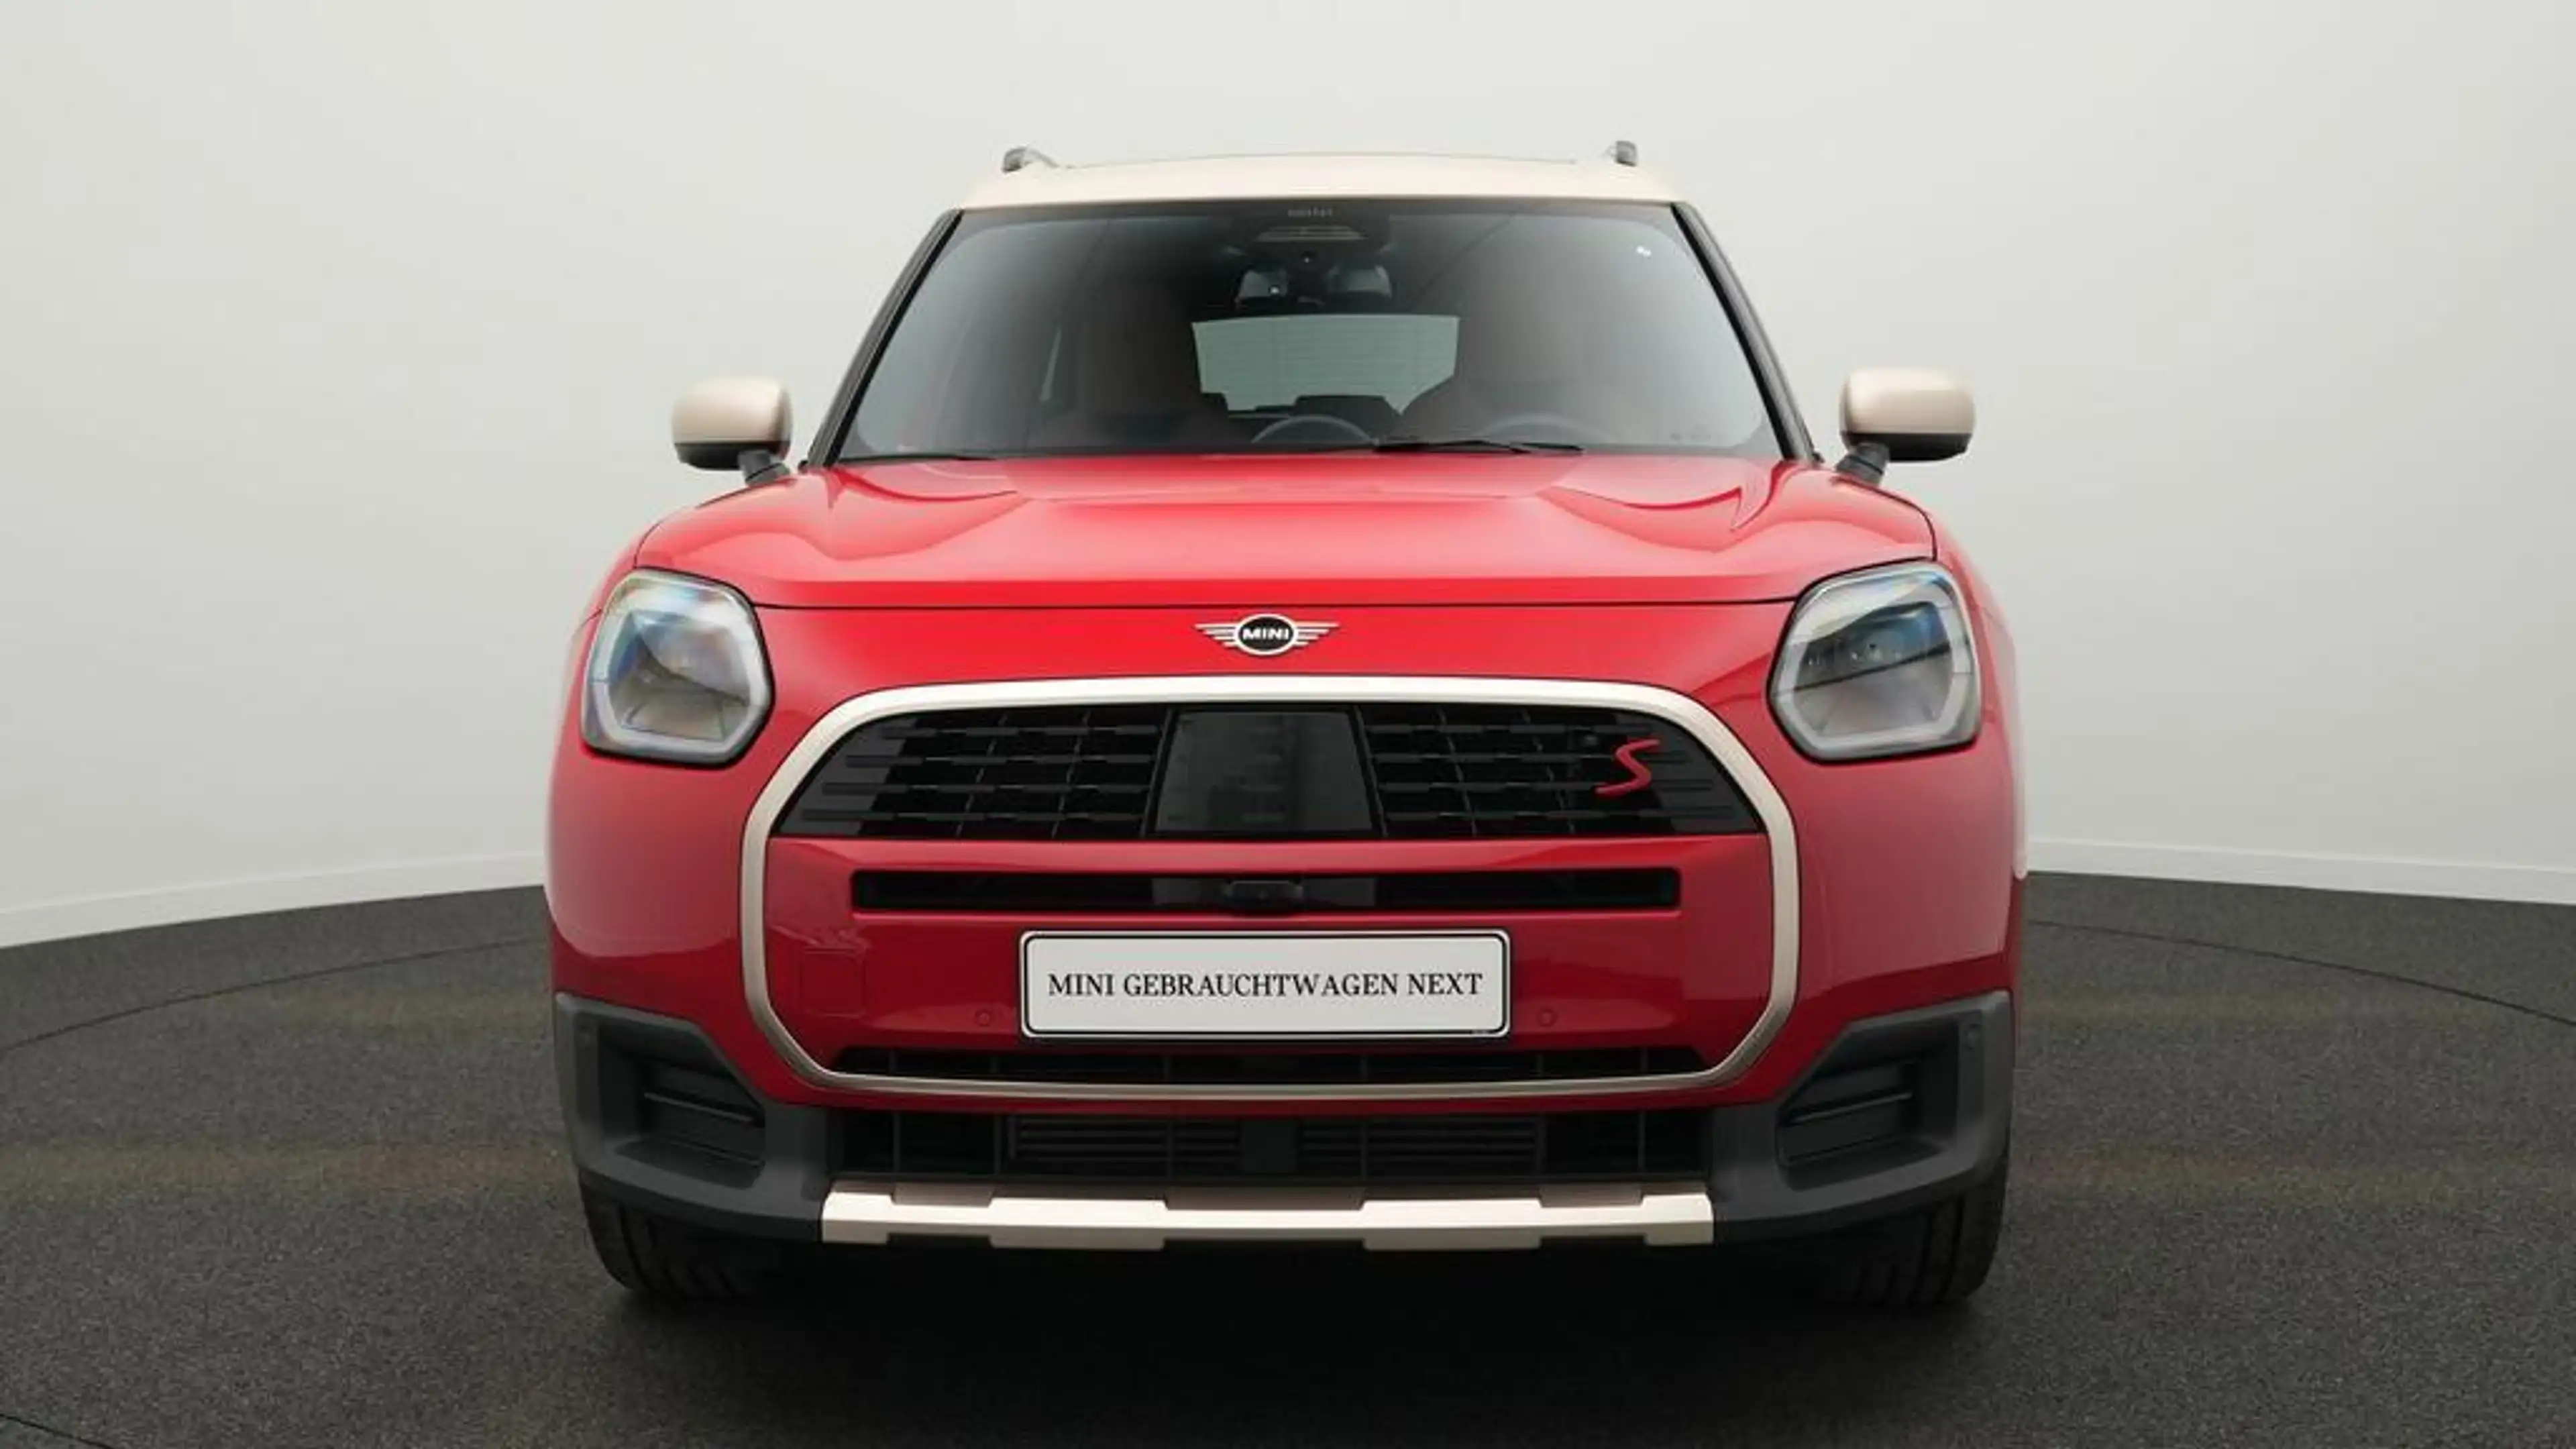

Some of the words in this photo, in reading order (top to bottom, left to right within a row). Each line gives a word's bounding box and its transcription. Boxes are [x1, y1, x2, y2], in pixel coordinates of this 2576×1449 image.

[1242, 628, 1289, 640] MINI
[1595, 739, 1660, 797] S
[1048, 973, 1114, 996] MINI
[1123, 973, 1399, 996] GEBRAUCHTWAGEN
[1407, 973, 1483, 996] NEXT
